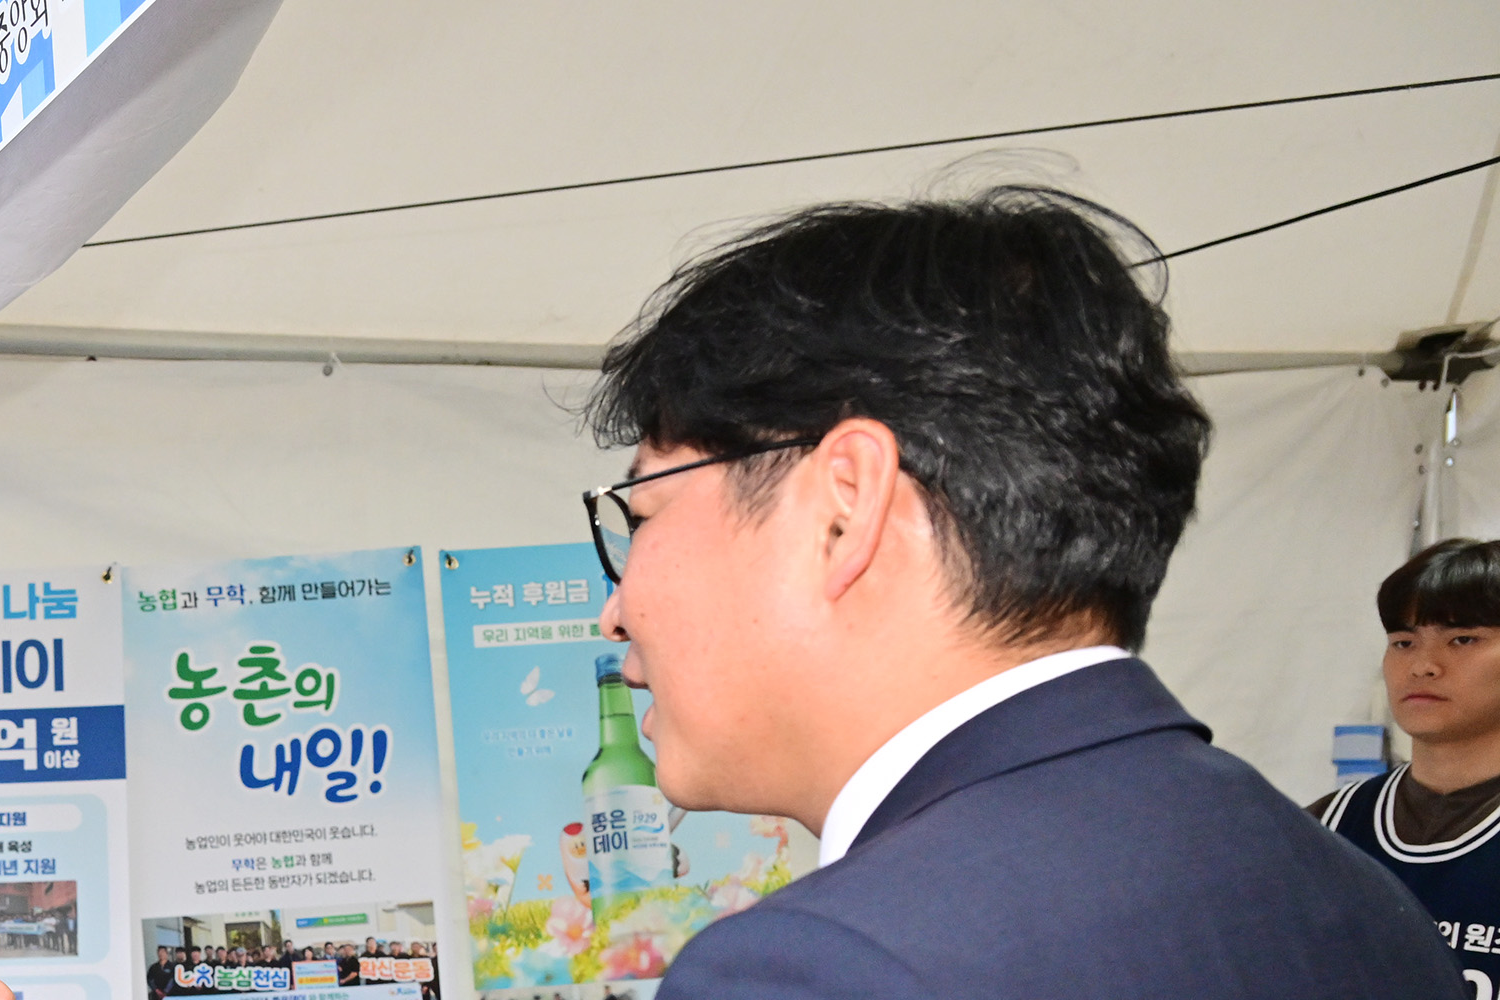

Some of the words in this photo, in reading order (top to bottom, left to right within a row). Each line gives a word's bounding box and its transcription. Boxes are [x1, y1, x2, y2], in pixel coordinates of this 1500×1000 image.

[2, 582, 79, 620] 나눔
[138, 589, 198, 612] 농협과
[259, 585, 296, 604] 함께
[301, 578, 392, 601] 만들어가는
[470, 583, 515, 610] 누적
[522, 578, 589, 606] 후원금
[483, 628, 509, 643] 우리
[513, 625, 553, 642] 지역을
[168, 645, 335, 731] 농촌의
[51, 716, 79, 746] 원
[43, 750, 81, 769] 이상
[240, 728, 388, 803] 내일!
[592, 810, 627, 833] 좋은
[7, 840, 33, 854] 육성
[185, 834, 231, 850] 농업인이
[269, 827, 327, 845] 대한민국이
[593, 831, 628, 854] 데이
[23, 857, 57, 876] 지원
[271, 854, 306, 869] 농협과
[194, 879, 229, 895] 농업의
[231, 876, 265, 891] 든든한
[267, 873, 313, 889] 동반자가
[217, 969, 288, 988] 농심천심
